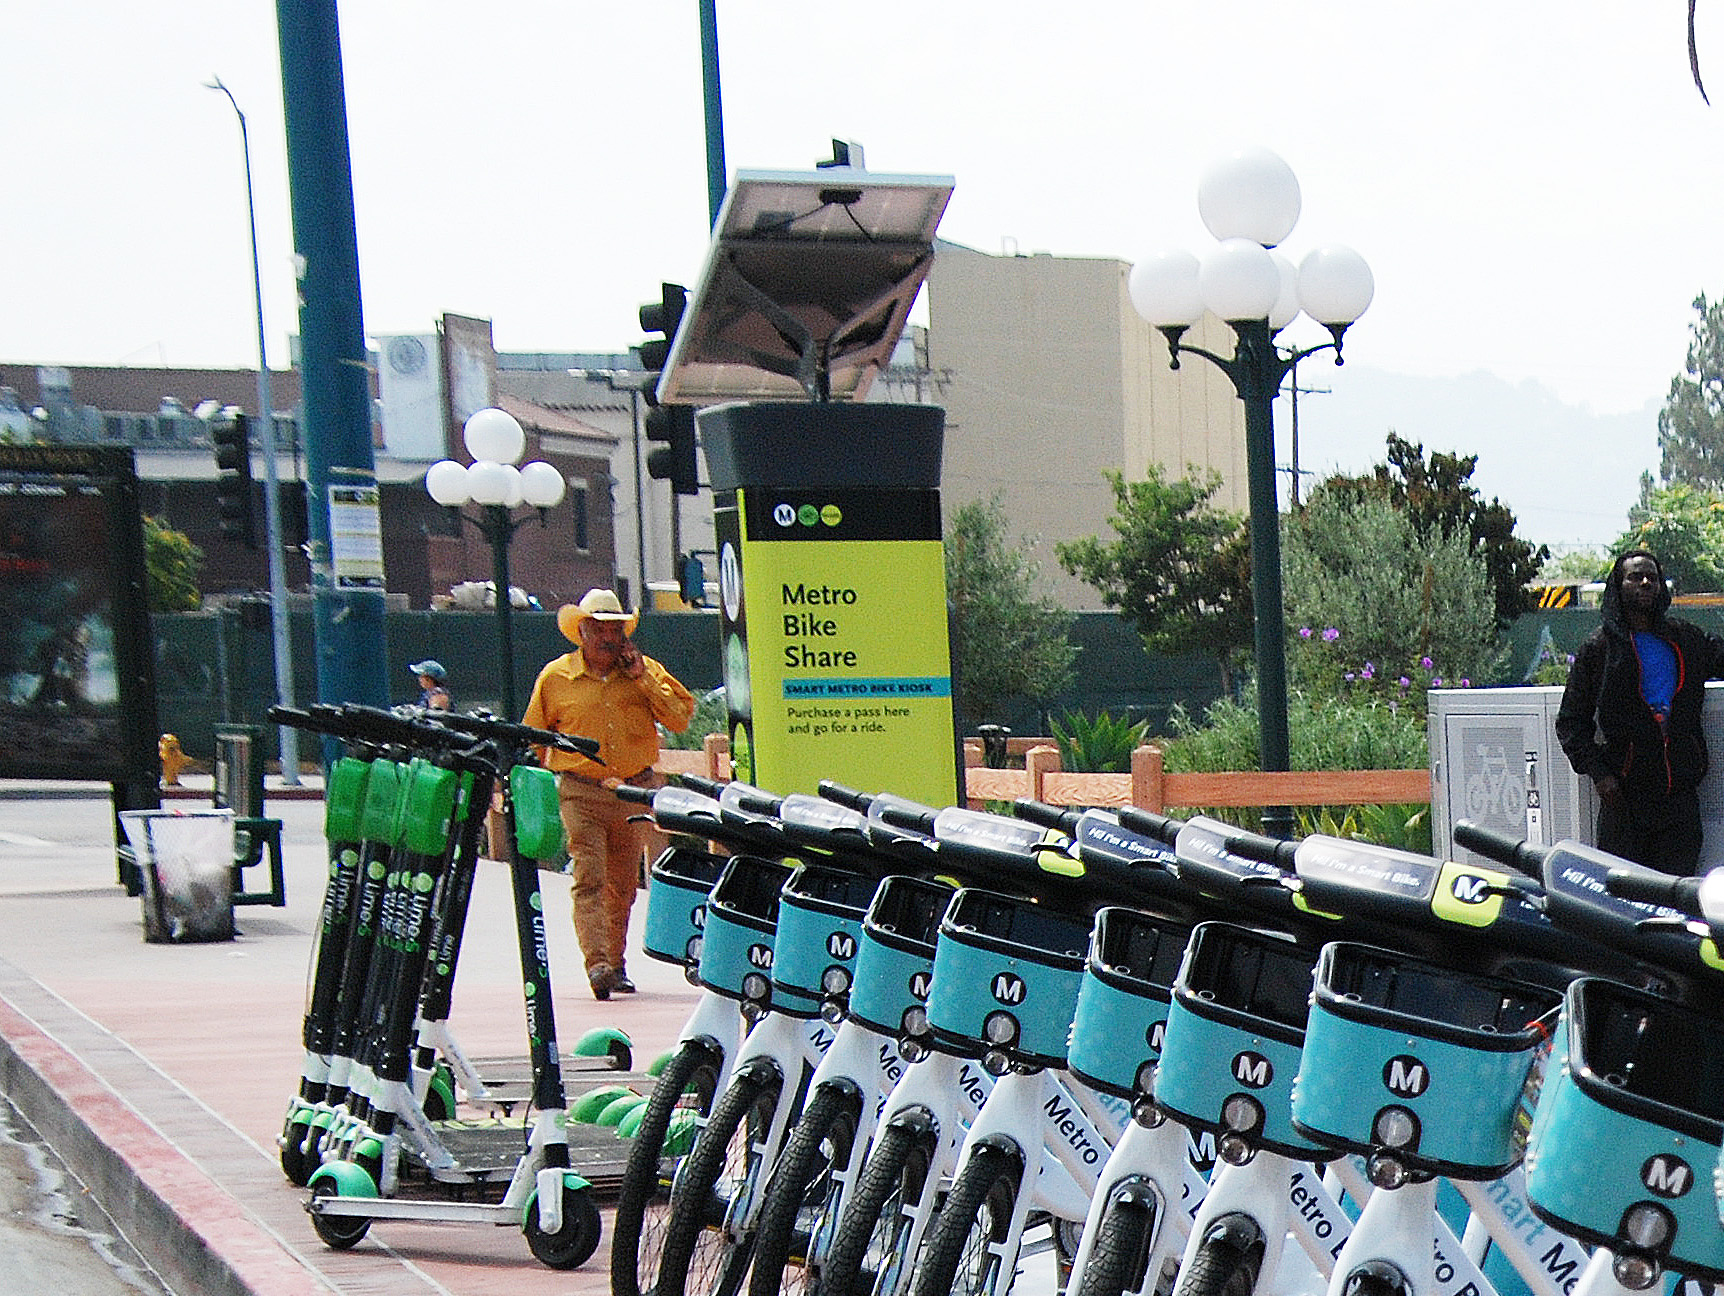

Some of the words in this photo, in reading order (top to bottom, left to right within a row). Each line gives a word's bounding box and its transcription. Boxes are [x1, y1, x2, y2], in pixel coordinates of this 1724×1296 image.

[782, 584, 857, 605] Metro
[784, 613, 837, 636] Bike
[785, 645, 857, 668] Share
[785, 684, 824, 694] SMART
[828, 684, 867, 693] METRO
[870, 683, 895, 693] BIKE
[898, 683, 933, 692] KIOSK
[787, 707, 841, 718] Purchase
[854, 709, 881, 719] pass
[884, 706, 910, 717] here
[788, 722, 810, 734] and
[813, 725, 829, 736] go
[831, 721, 848, 733] for
[860, 721, 886, 733] ride.
[1128, 842, 1159, 858] Smart
[1357, 865, 1392, 881] Smart
[1043, 1094, 1099, 1165] Metro
